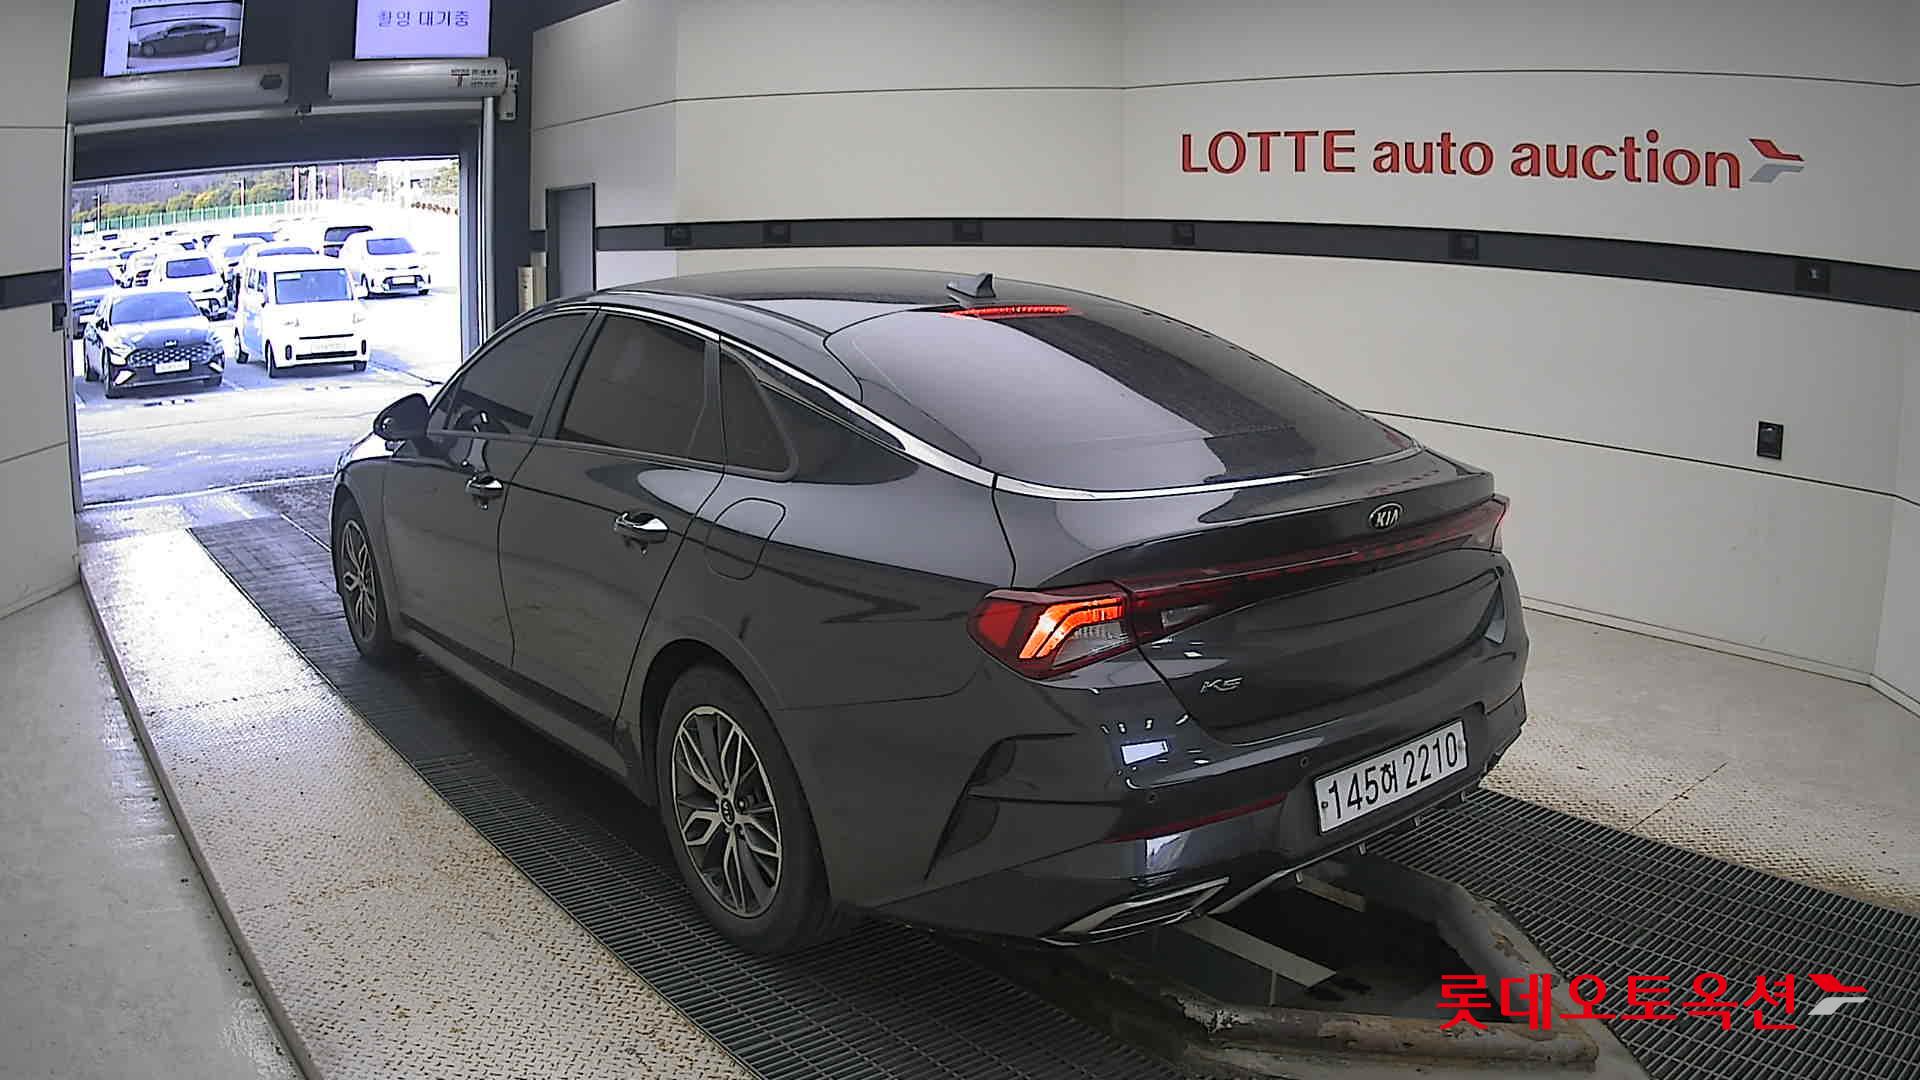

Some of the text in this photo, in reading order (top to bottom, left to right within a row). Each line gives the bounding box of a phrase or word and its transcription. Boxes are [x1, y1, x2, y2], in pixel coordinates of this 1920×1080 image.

[419, 10, 469, 27] 대기중
[1181, 129, 1741, 188] LOTTE auto auction
[1376, 508, 1401, 527] KIA
[1200, 677, 1243, 693] K5
[1403, 732, 1458, 789] 2210
